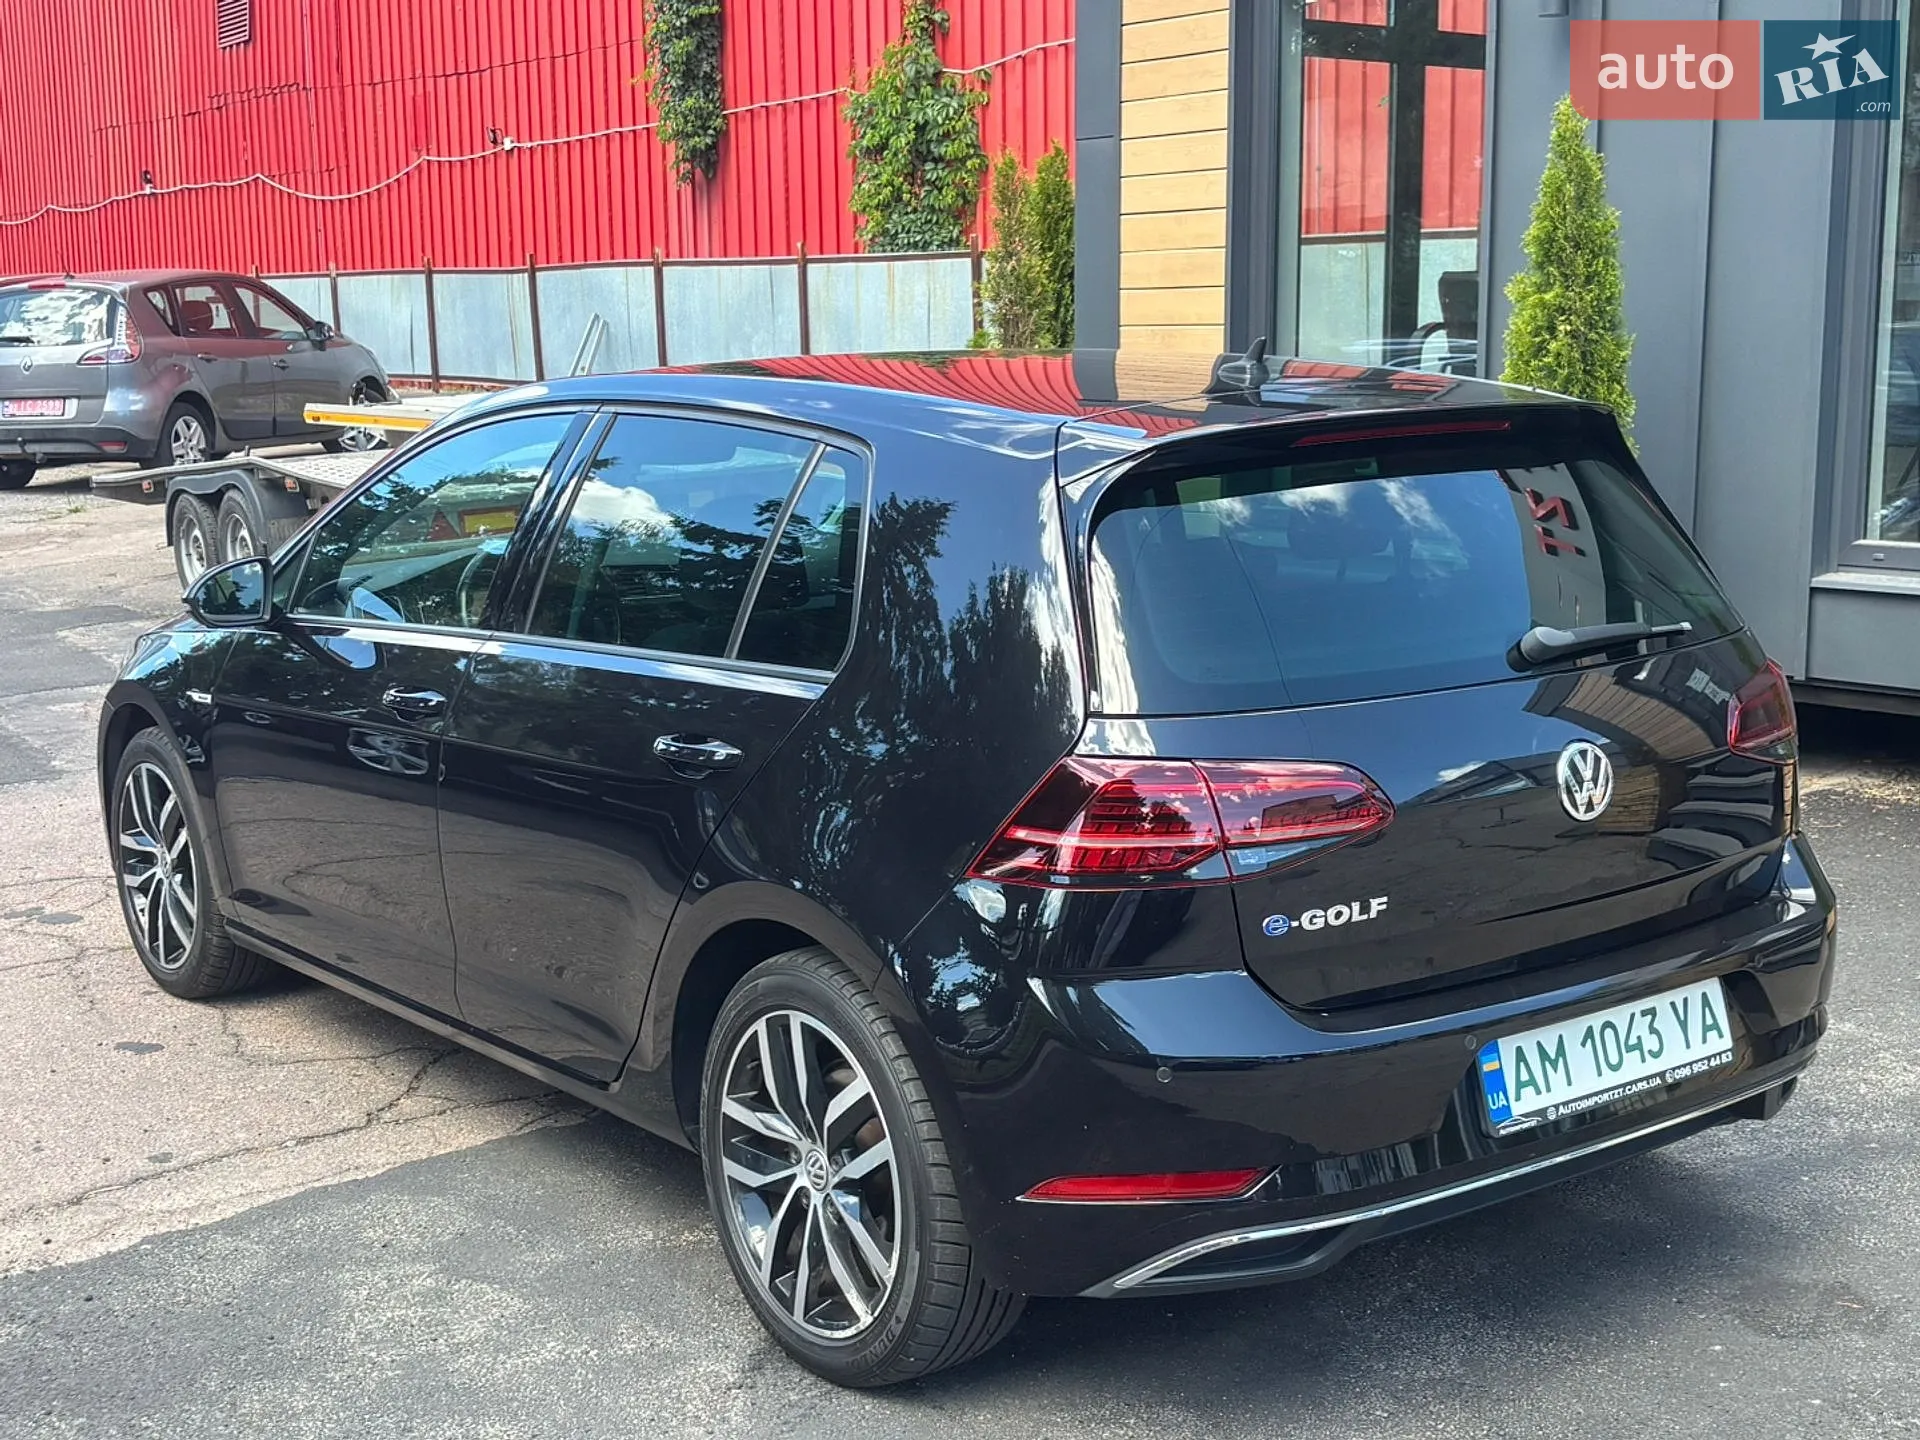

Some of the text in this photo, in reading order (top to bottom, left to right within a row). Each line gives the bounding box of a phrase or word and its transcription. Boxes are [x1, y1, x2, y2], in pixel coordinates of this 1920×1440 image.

[1262, 896, 1389, 937] e-GOLF
[1514, 991, 1724, 1102] AM 1043 YA
[1488, 1094, 1508, 1110] UA
